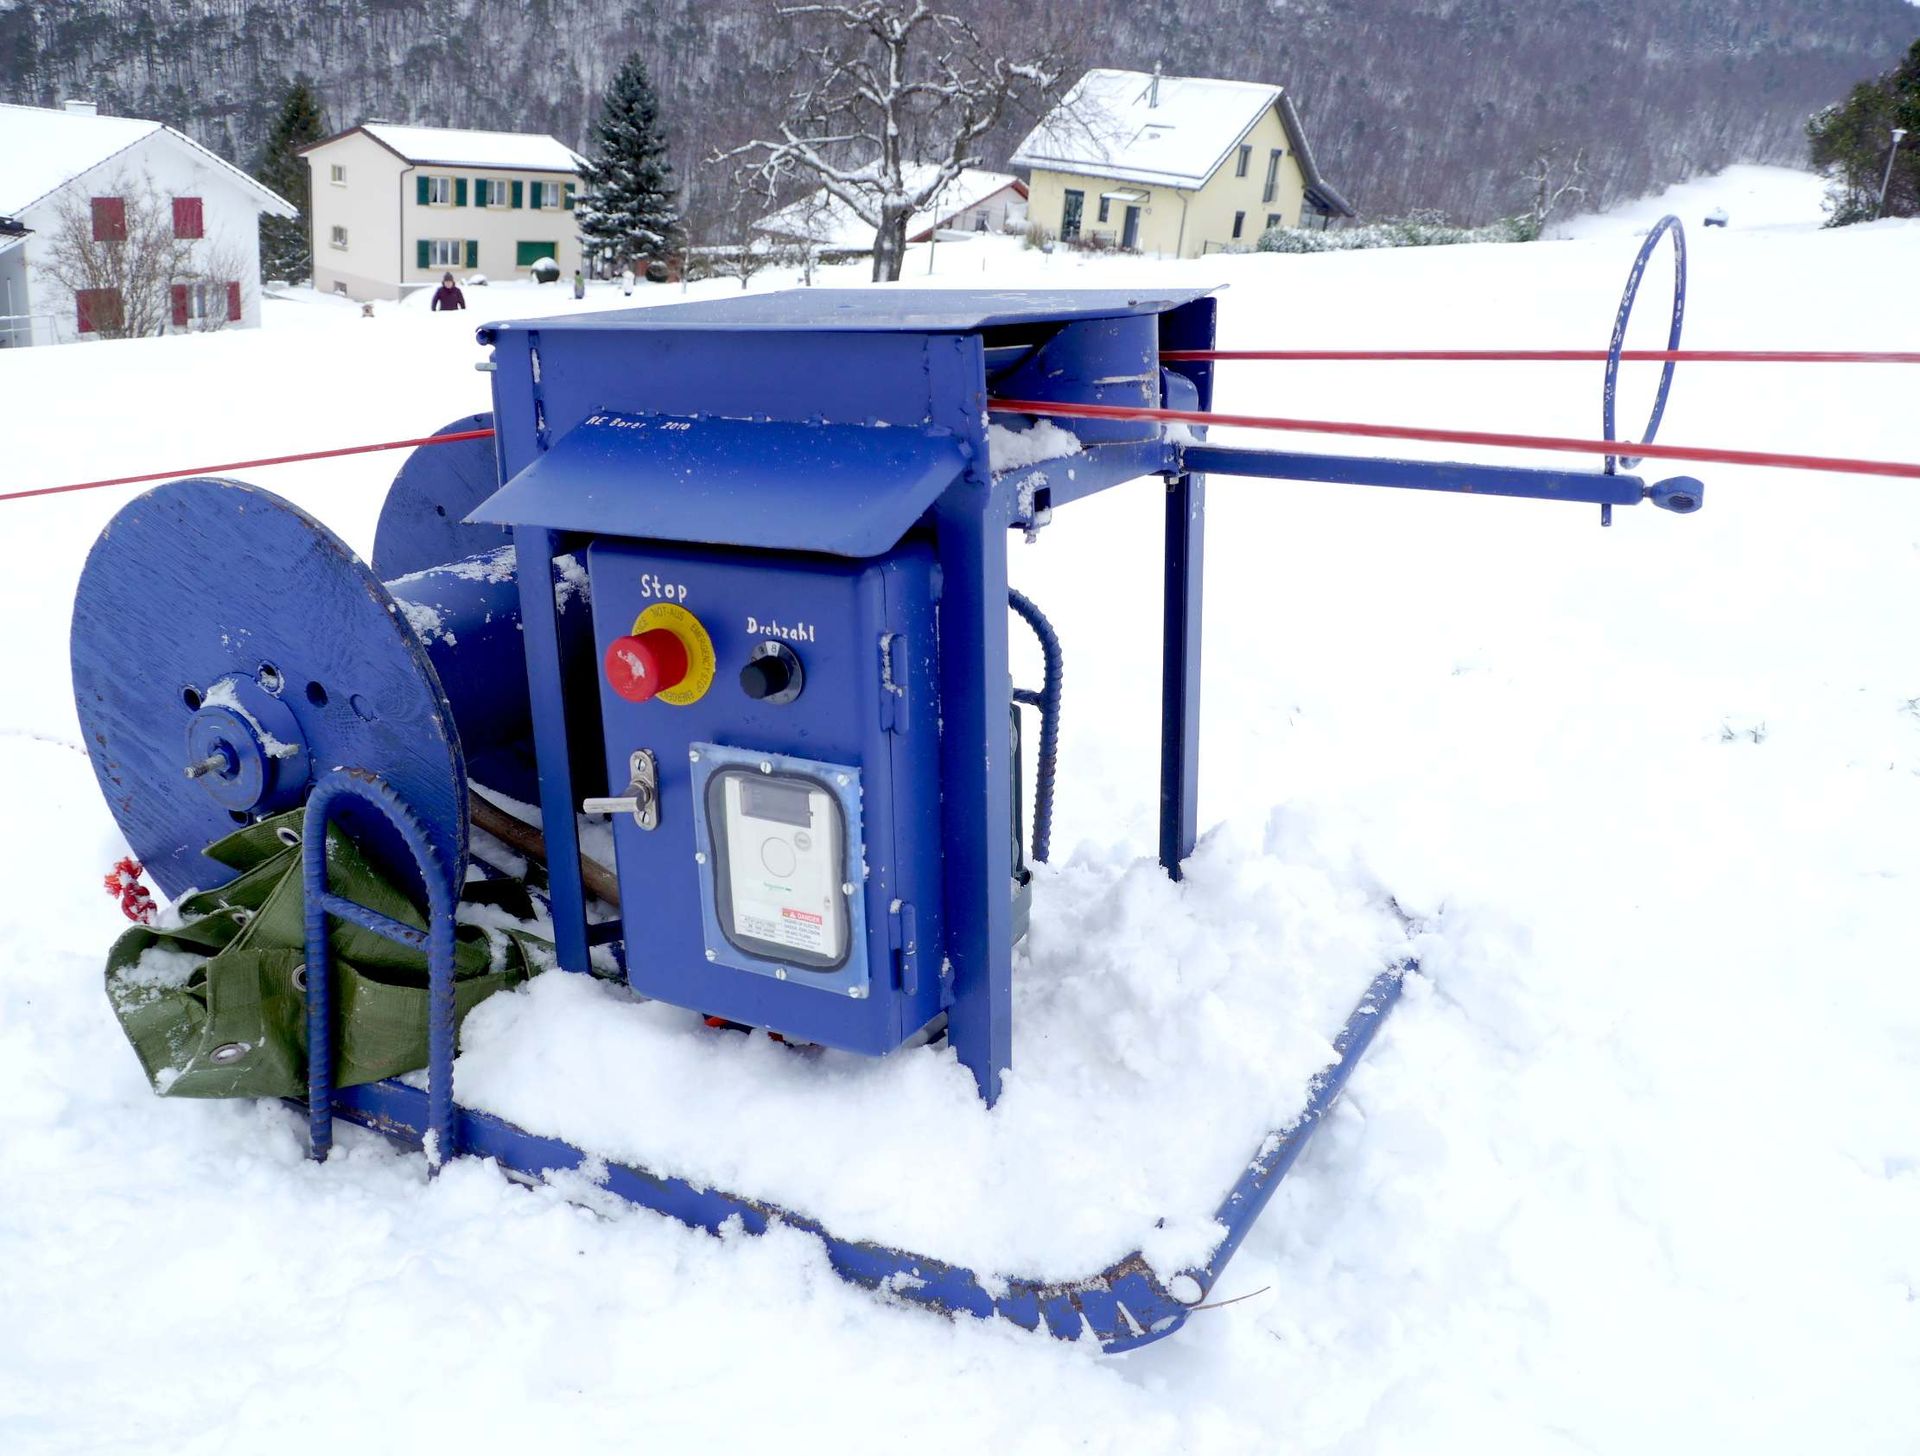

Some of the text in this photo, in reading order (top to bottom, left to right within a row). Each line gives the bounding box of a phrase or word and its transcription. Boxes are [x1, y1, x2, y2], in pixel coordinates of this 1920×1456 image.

[641, 574, 688, 603] Stop
[746, 616, 815, 642] Drehzahl
[771, 643, 777, 653] 8
[797, 912, 820, 922] DANGER
